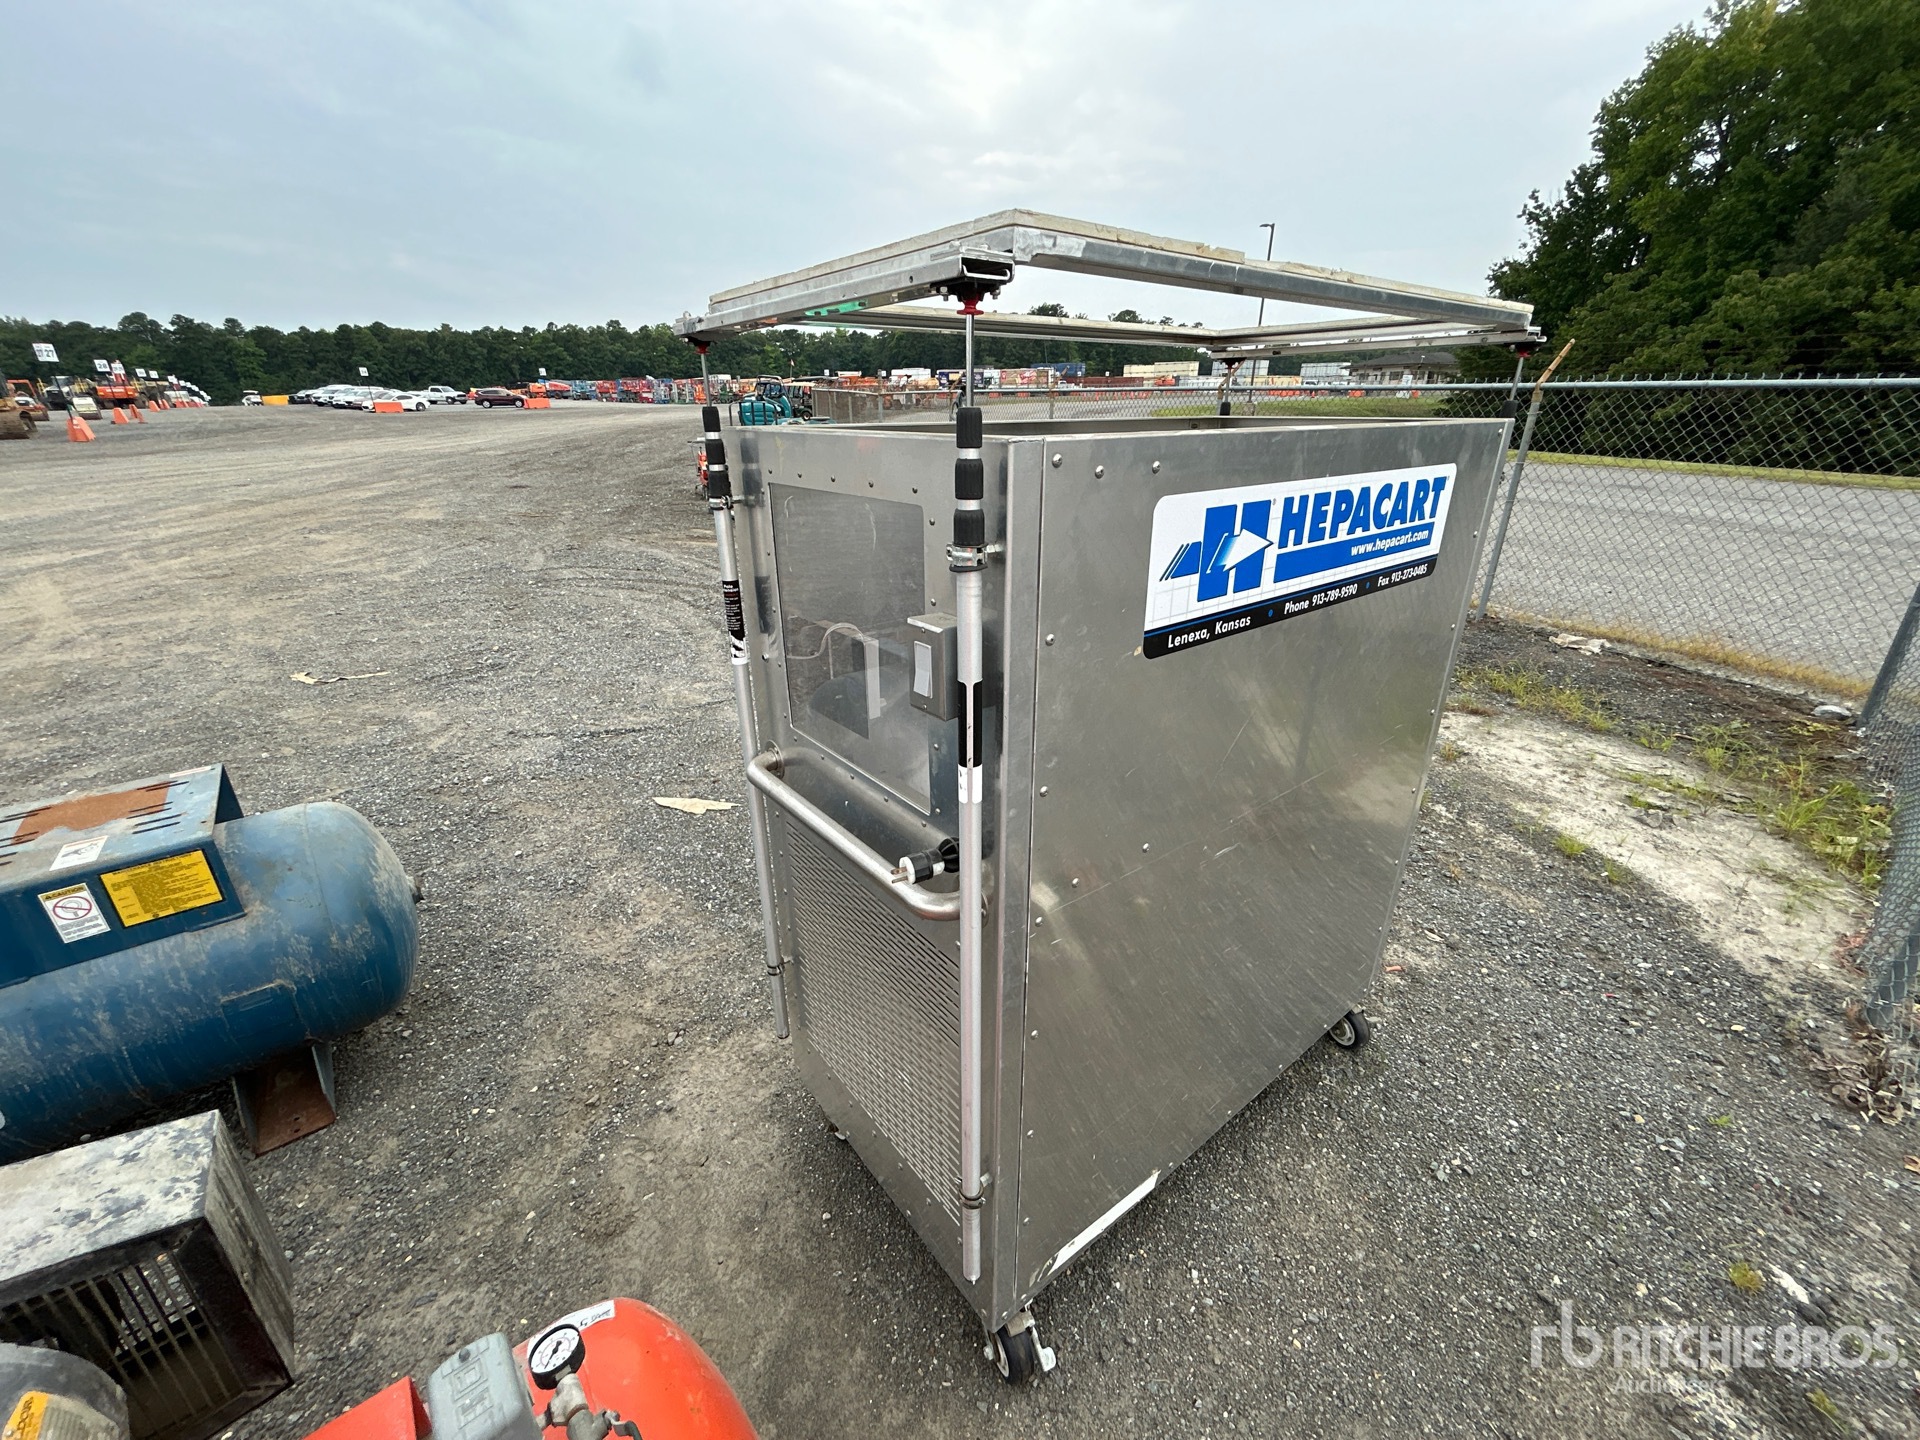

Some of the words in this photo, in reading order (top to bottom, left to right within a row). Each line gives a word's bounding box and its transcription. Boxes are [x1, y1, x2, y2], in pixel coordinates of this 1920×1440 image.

[1278, 476, 1447, 549] HEPACART
[1351, 530, 1429, 556] www.hepacart.com
[1168, 629, 1210, 648] Lenexa,
[1215, 616, 1251, 635] Kansas
[1284, 599, 1309, 615] Phone
[1312, 584, 1358, 607] 913-789-9590
[1378, 575, 1390, 587] Fax
[1391, 563, 1428, 583] 913-273-0485
